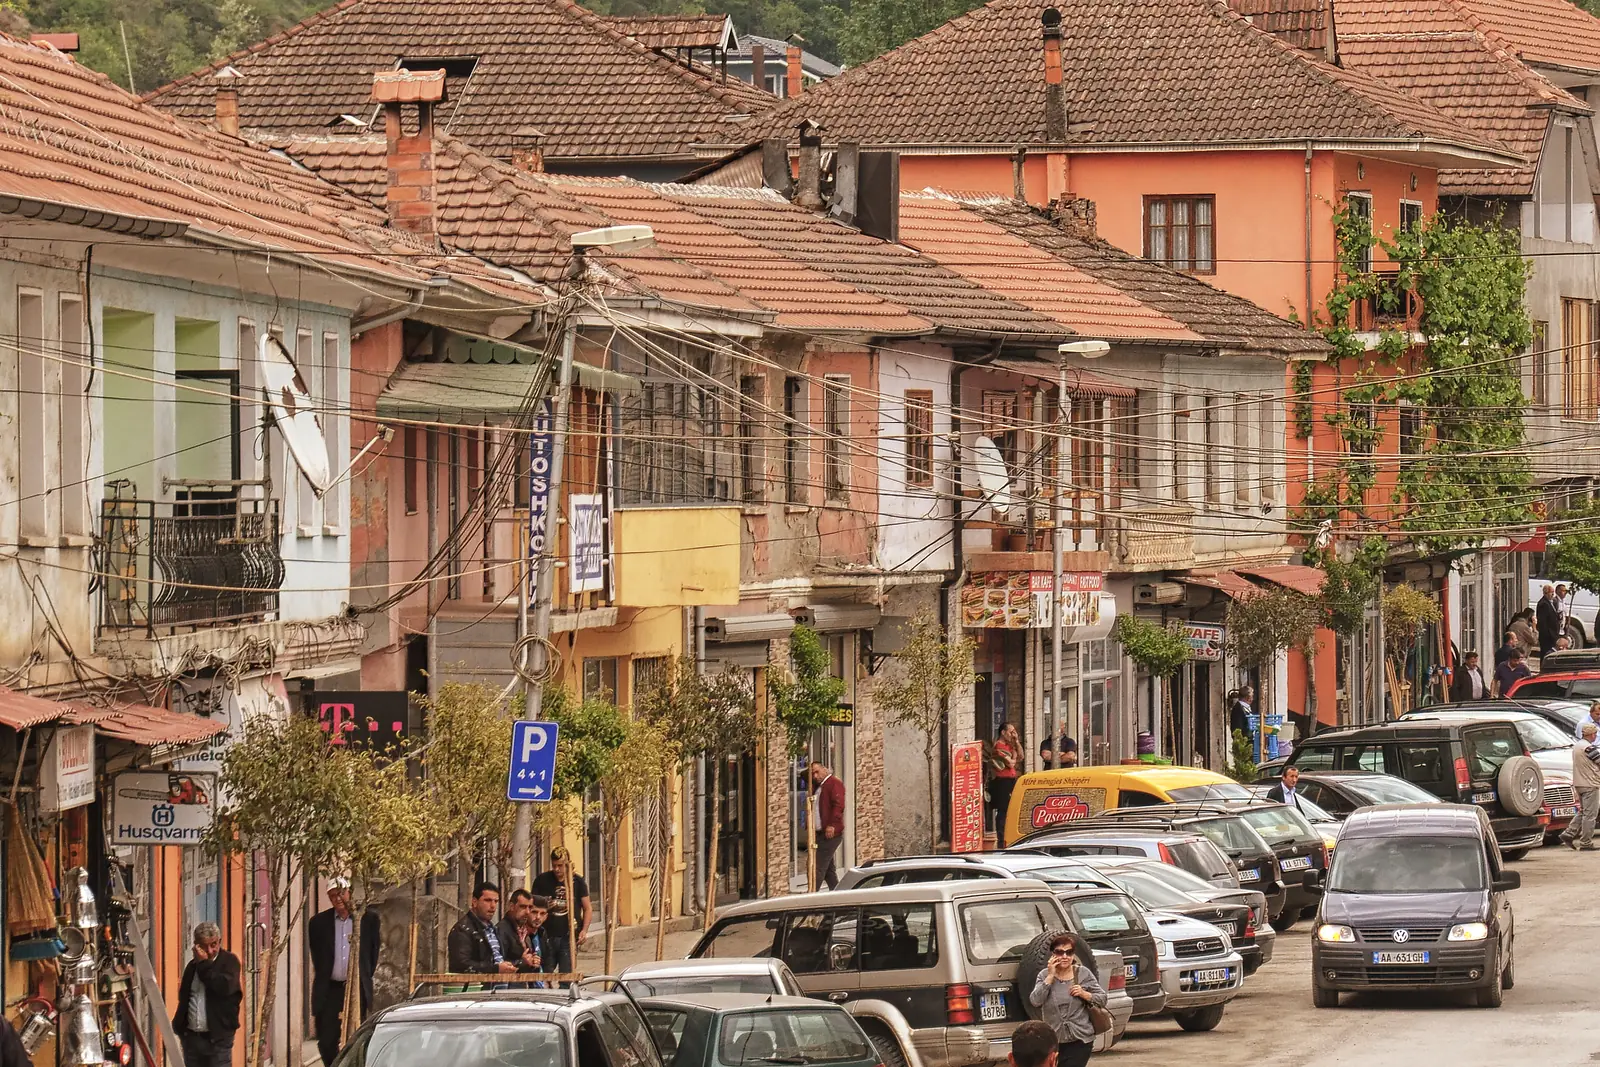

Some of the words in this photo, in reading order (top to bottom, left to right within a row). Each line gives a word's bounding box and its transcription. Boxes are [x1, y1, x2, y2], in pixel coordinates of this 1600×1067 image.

[1041, 575, 1052, 588] KAFE
[522, 726, 547, 762] P
[1036, 808, 1085, 823] Pascalin
